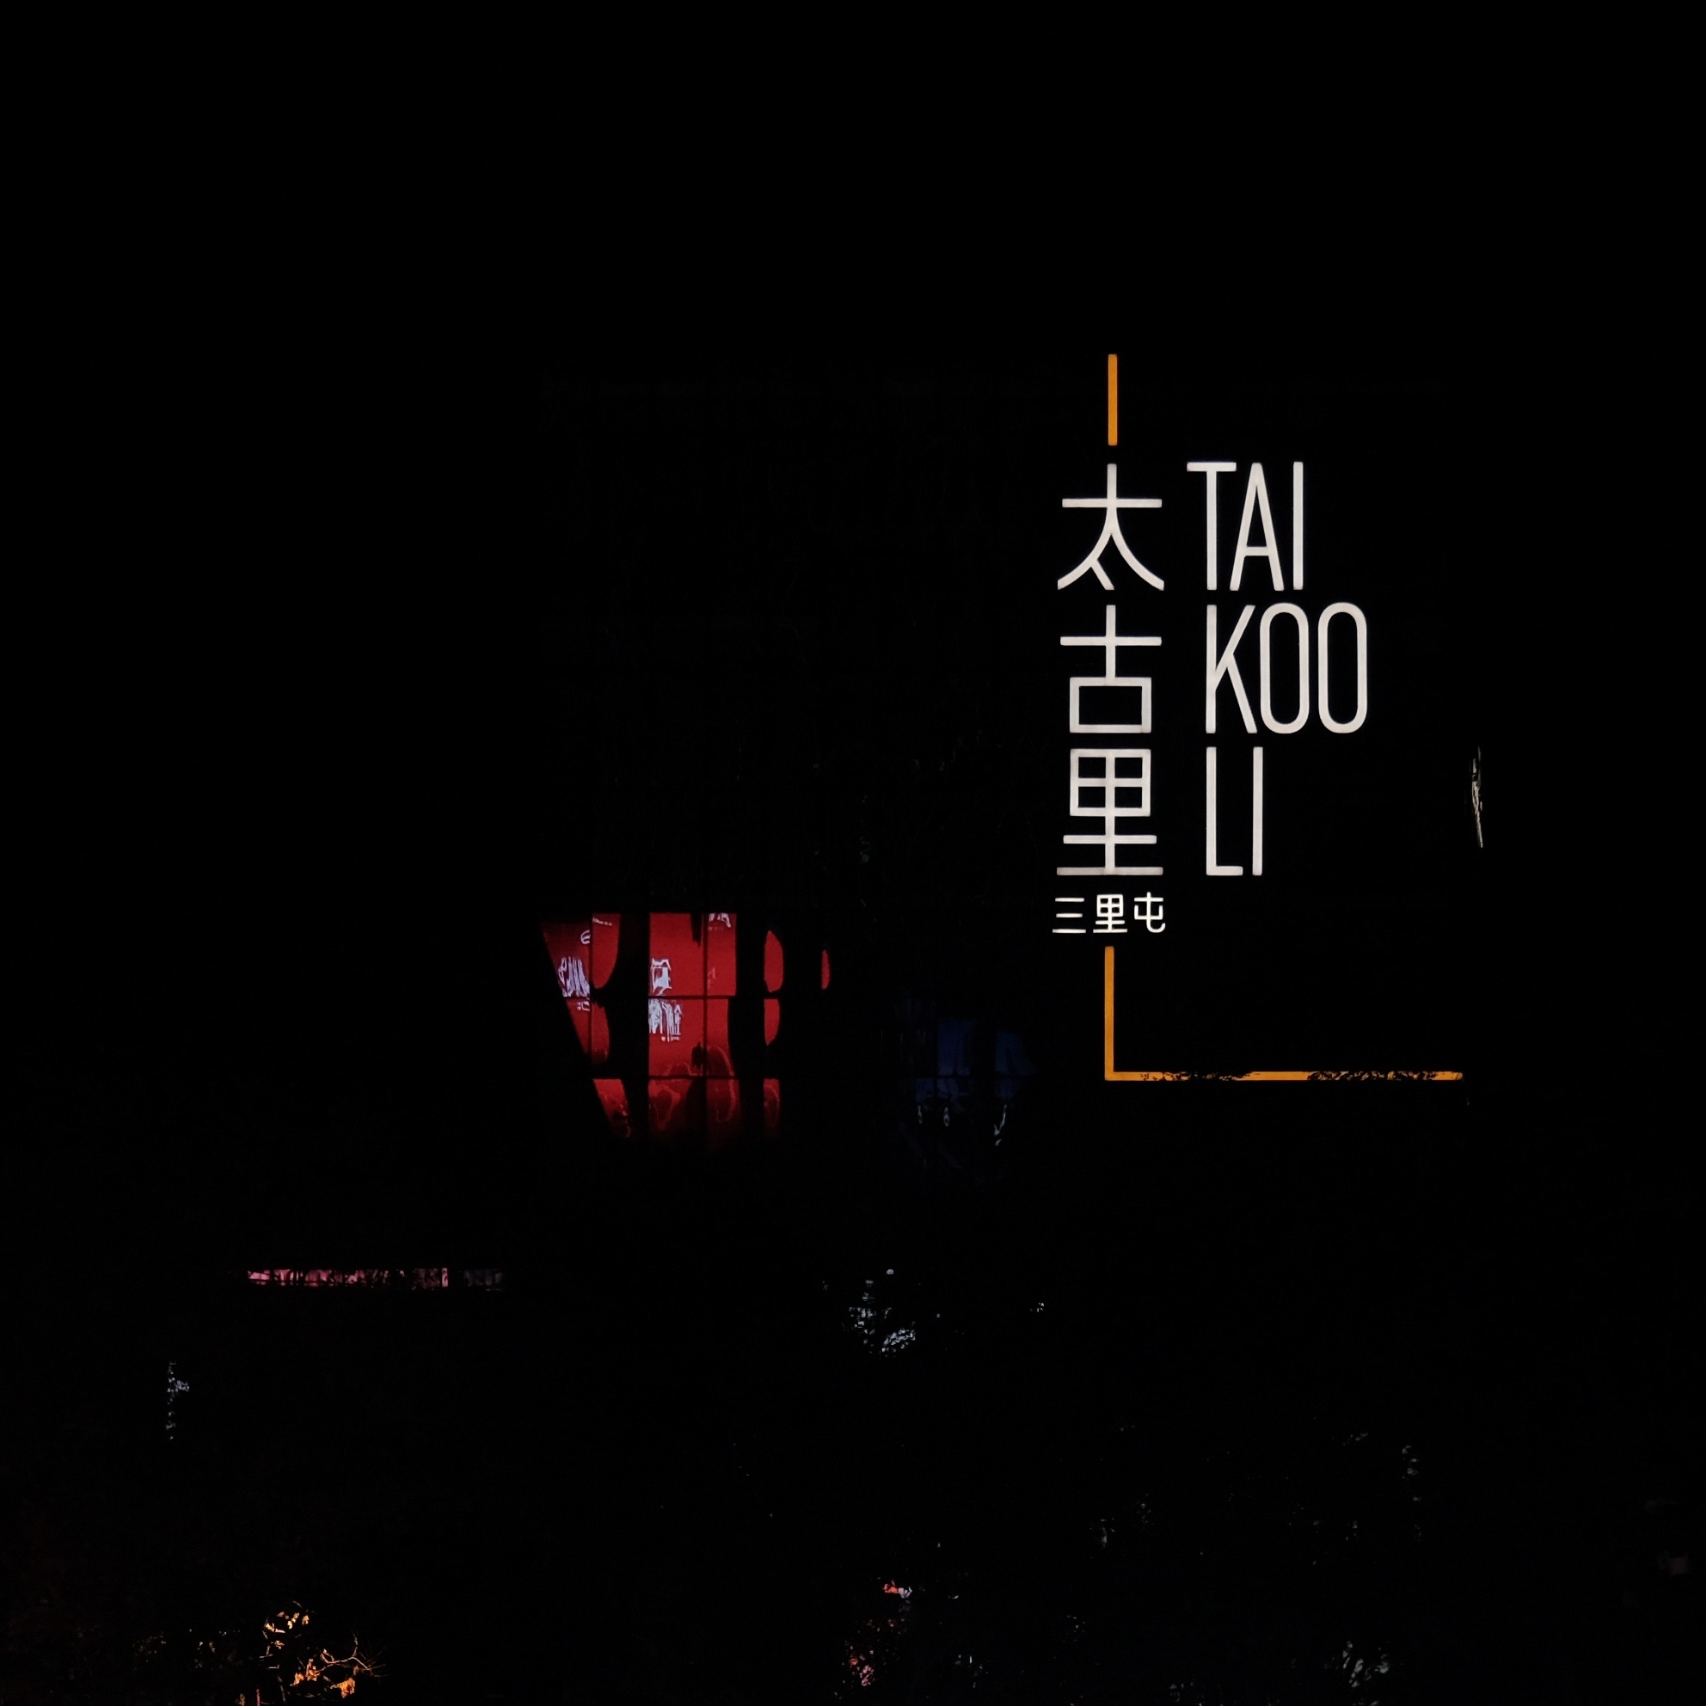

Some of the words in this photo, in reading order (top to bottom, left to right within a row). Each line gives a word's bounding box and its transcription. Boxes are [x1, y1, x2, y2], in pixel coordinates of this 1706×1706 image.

[1186, 461, 1304, 592] TAI
[1057, 463, 1165, 876] 太古里
[1205, 602, 1368, 734] KOO
[1205, 746, 1264, 876] LI
[1052, 891, 1166, 934] 三里屯
